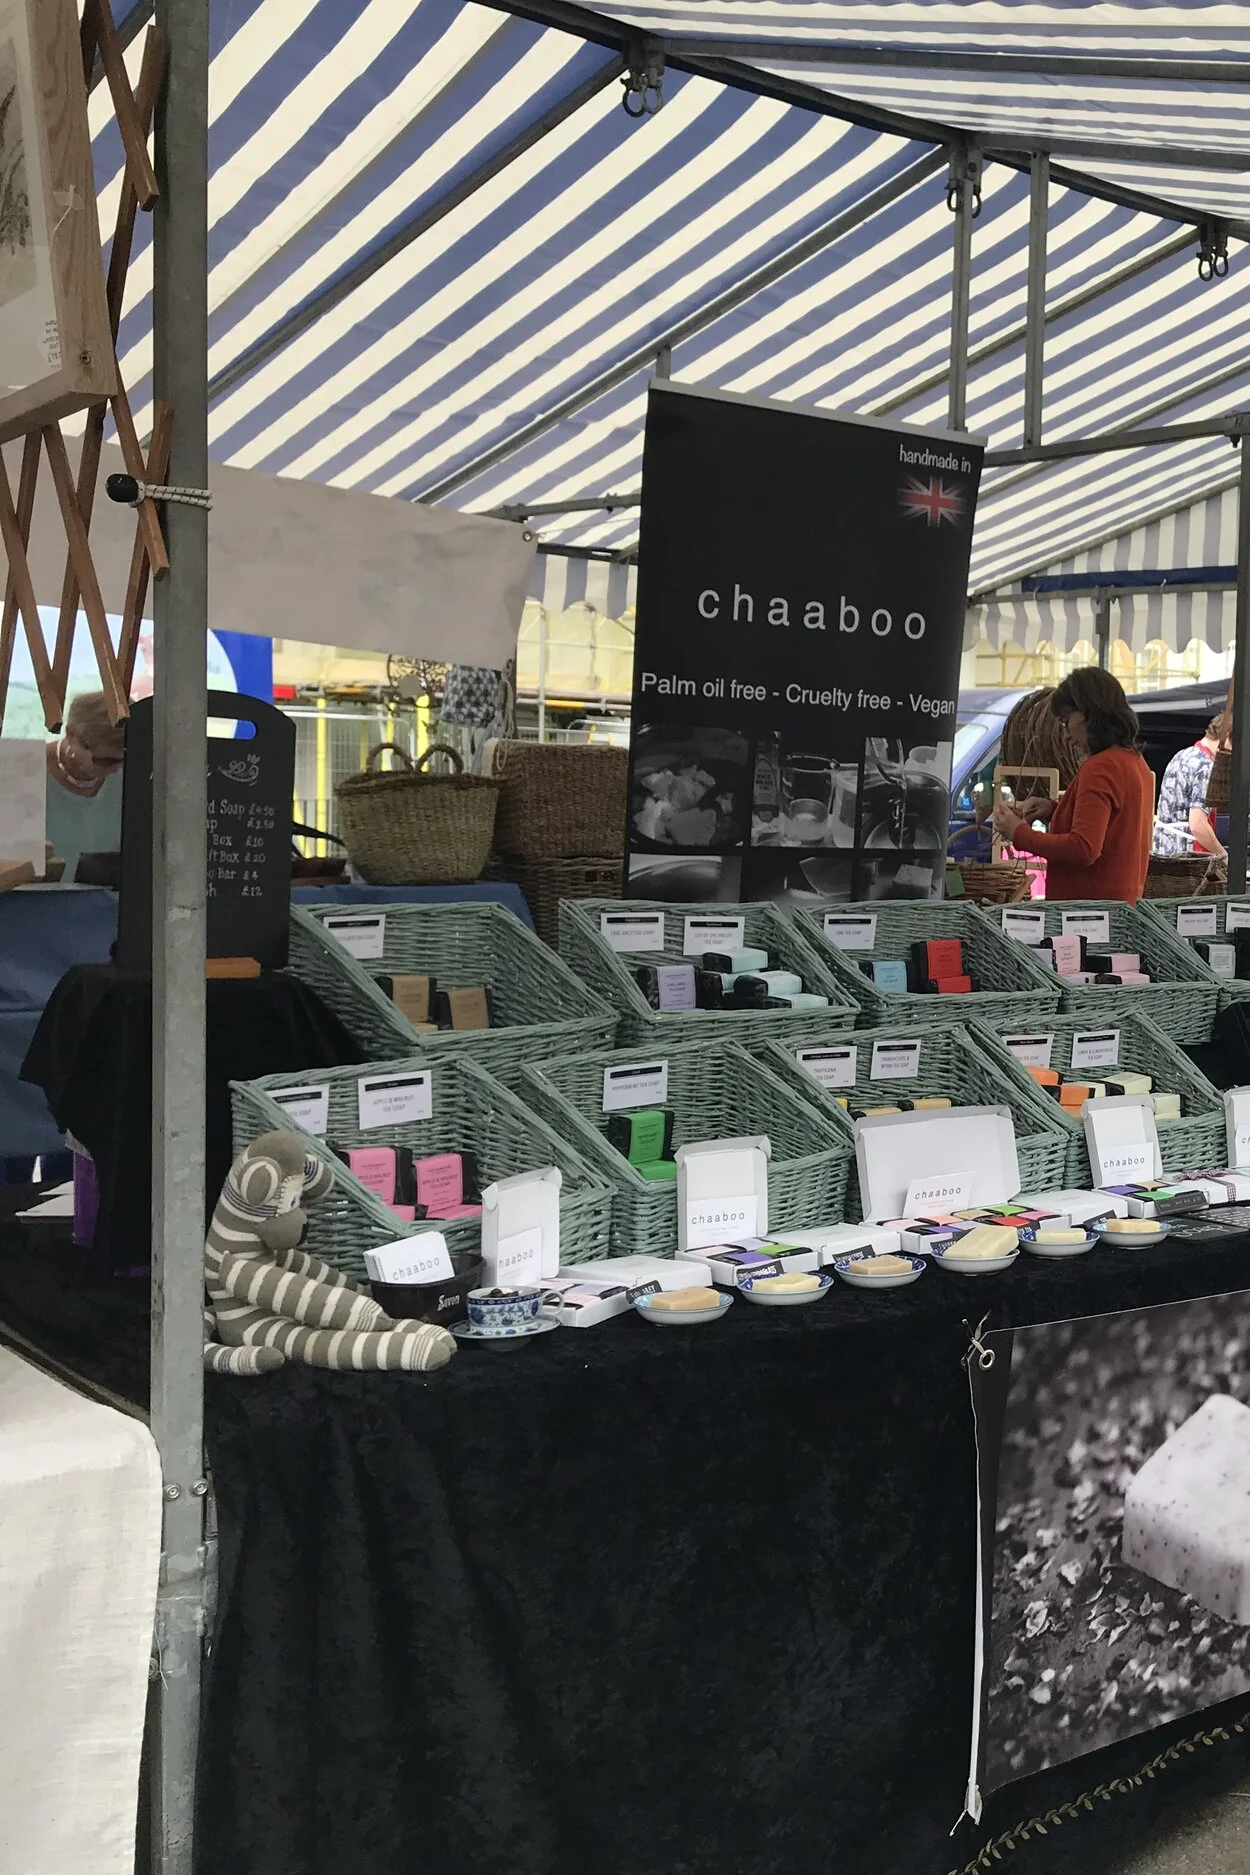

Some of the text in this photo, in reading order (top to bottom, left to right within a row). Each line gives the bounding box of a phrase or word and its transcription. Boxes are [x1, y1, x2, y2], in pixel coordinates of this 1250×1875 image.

[899, 444, 972, 473] handmade in
[697, 583, 927, 640] chaaboo
[640, 672, 696, 696] Palm
[702, 678, 725, 699] oil
[730, 679, 767, 702] free
[785, 683, 853, 712] Cruelty
[856, 688, 891, 711] free
[909, 693, 955, 718] Vegan
[220, 798, 245, 820] Soap
[212, 833, 232, 846] Box
[1103, 1156, 1145, 1168] chaaboo
[914, 1187, 961, 1200] chaaboo
[691, 1211, 745, 1225] chaaboo
[392, 1257, 440, 1281] chaaboo
[499, 1249, 534, 1269] haaboo
